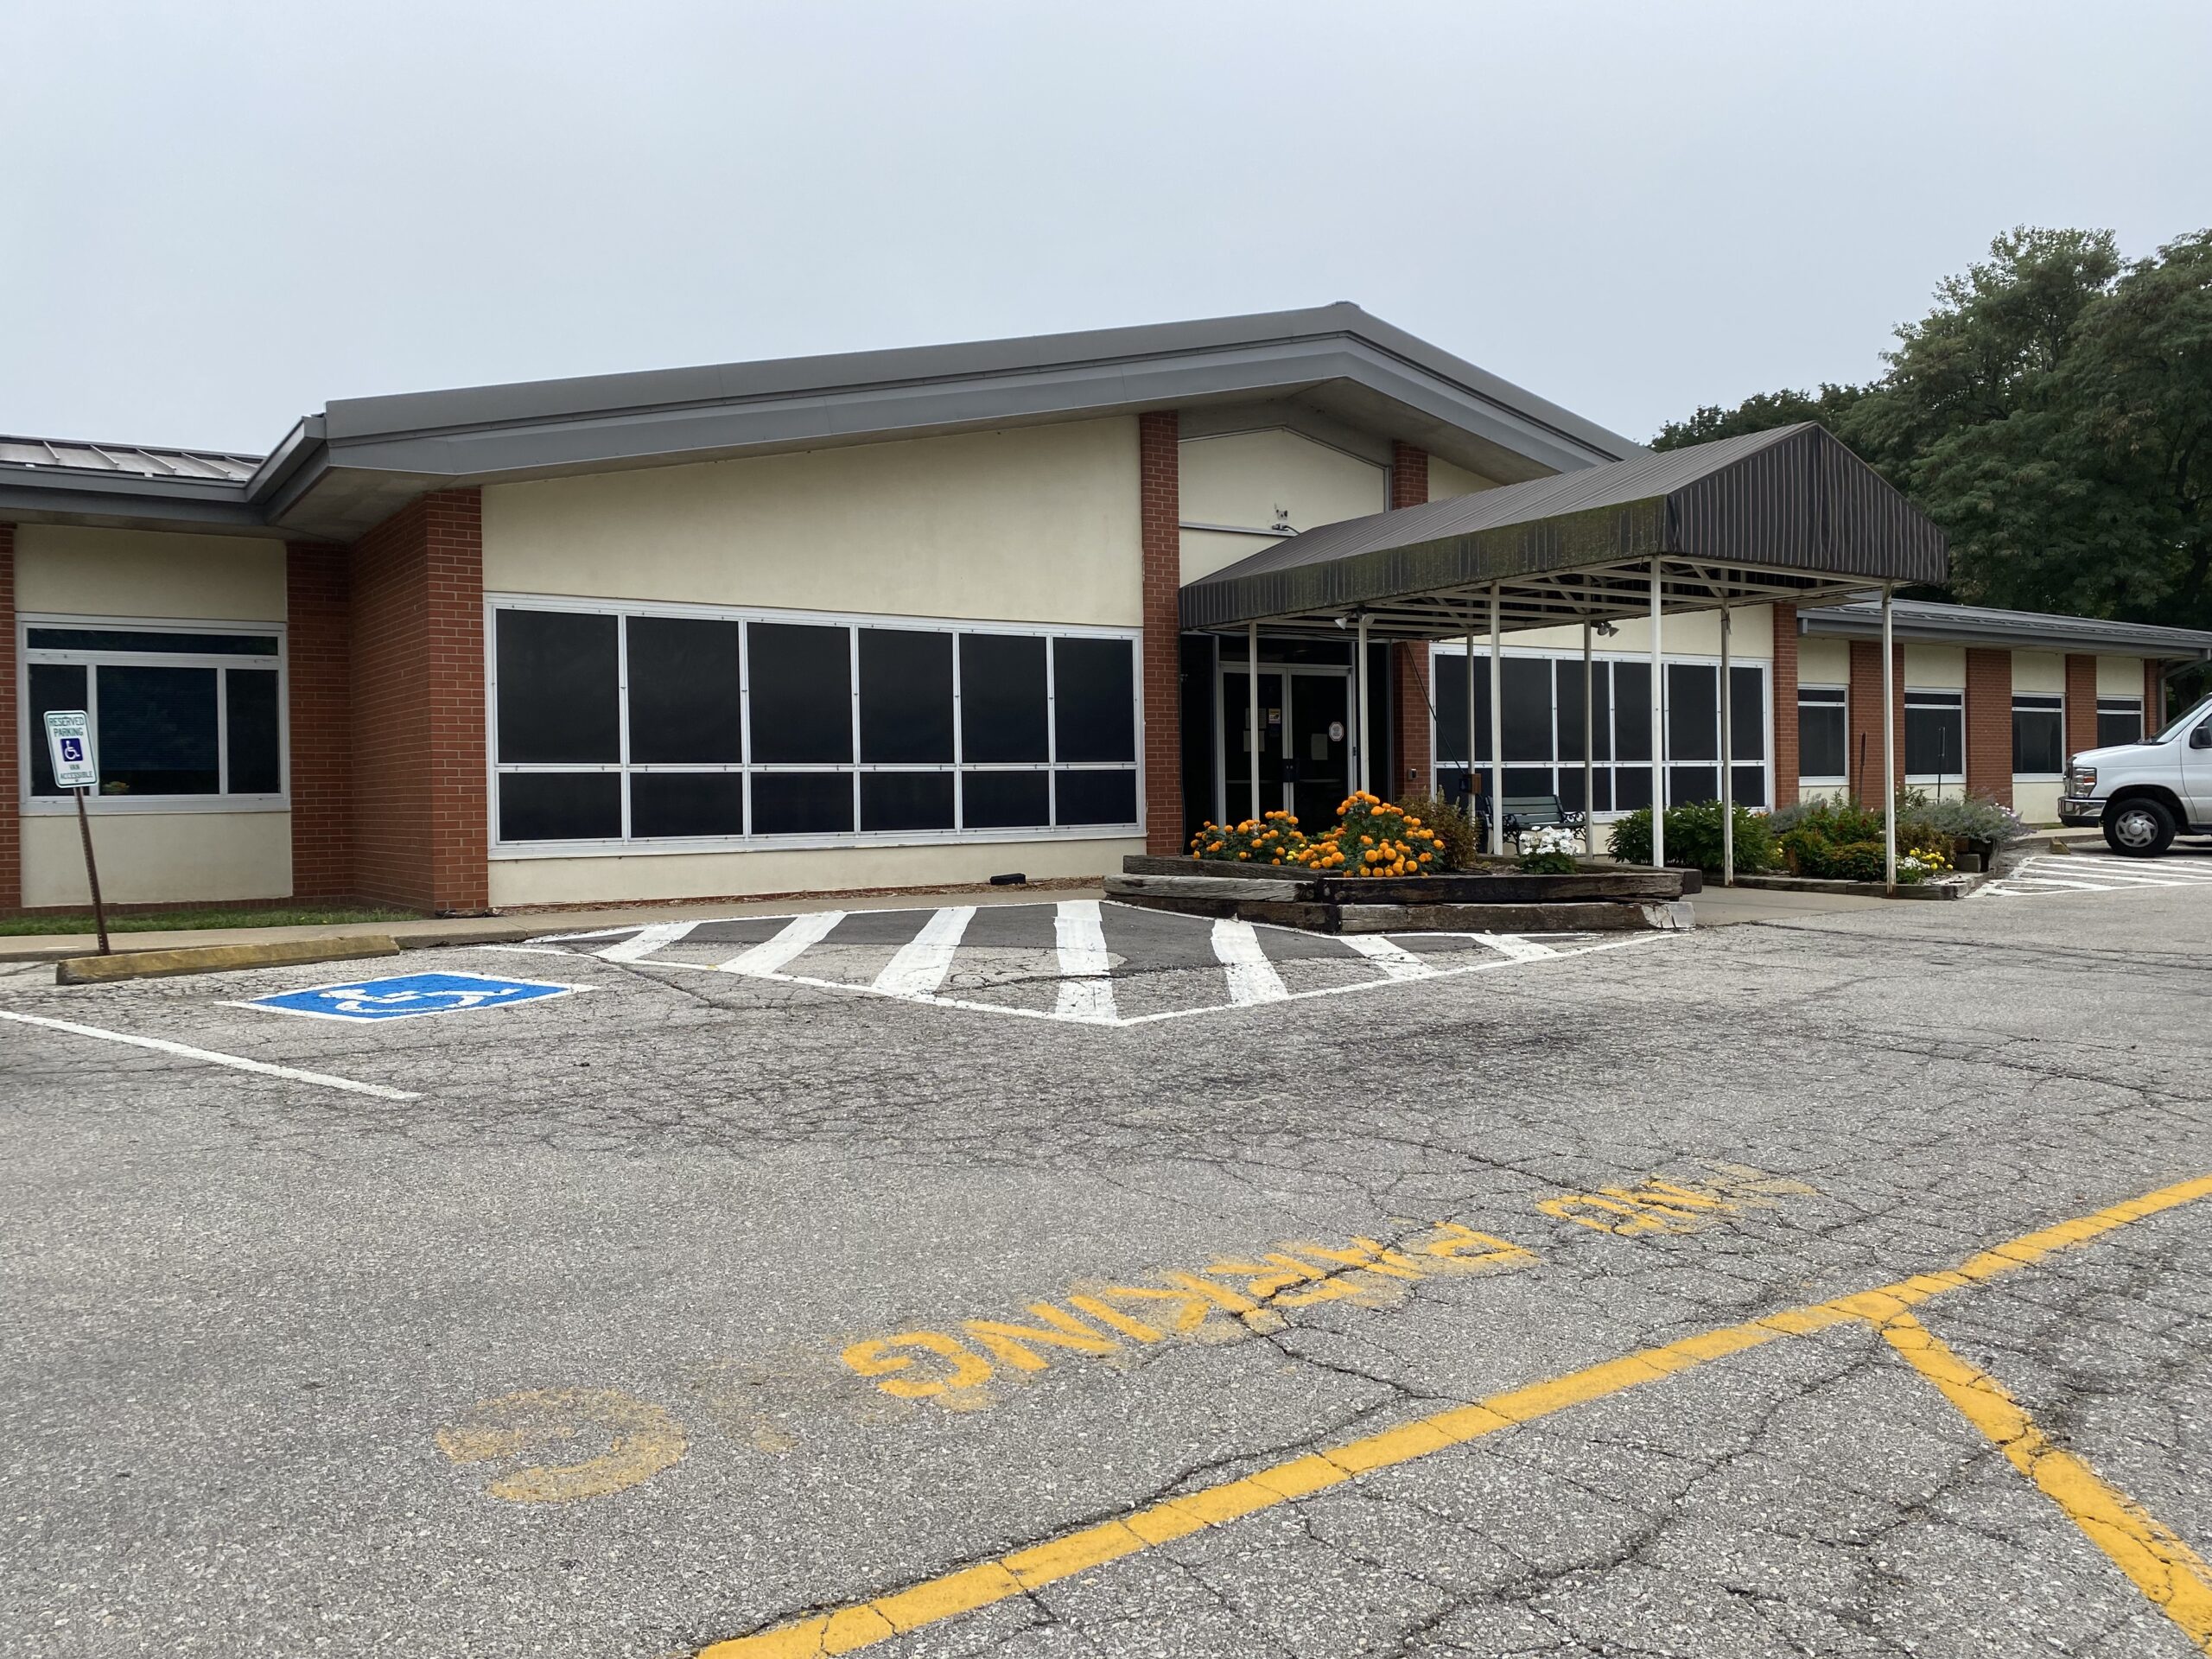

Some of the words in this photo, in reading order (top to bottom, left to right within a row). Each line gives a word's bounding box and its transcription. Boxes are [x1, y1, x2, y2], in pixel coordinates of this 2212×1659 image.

[49, 716, 85, 726] RESERVED
[54, 728, 83, 737] PARKING
[60, 771, 92, 779] ACCESSIBLE
[1537, 1179, 1726, 1236] NO
[840, 1221, 1538, 1399] PARKING
